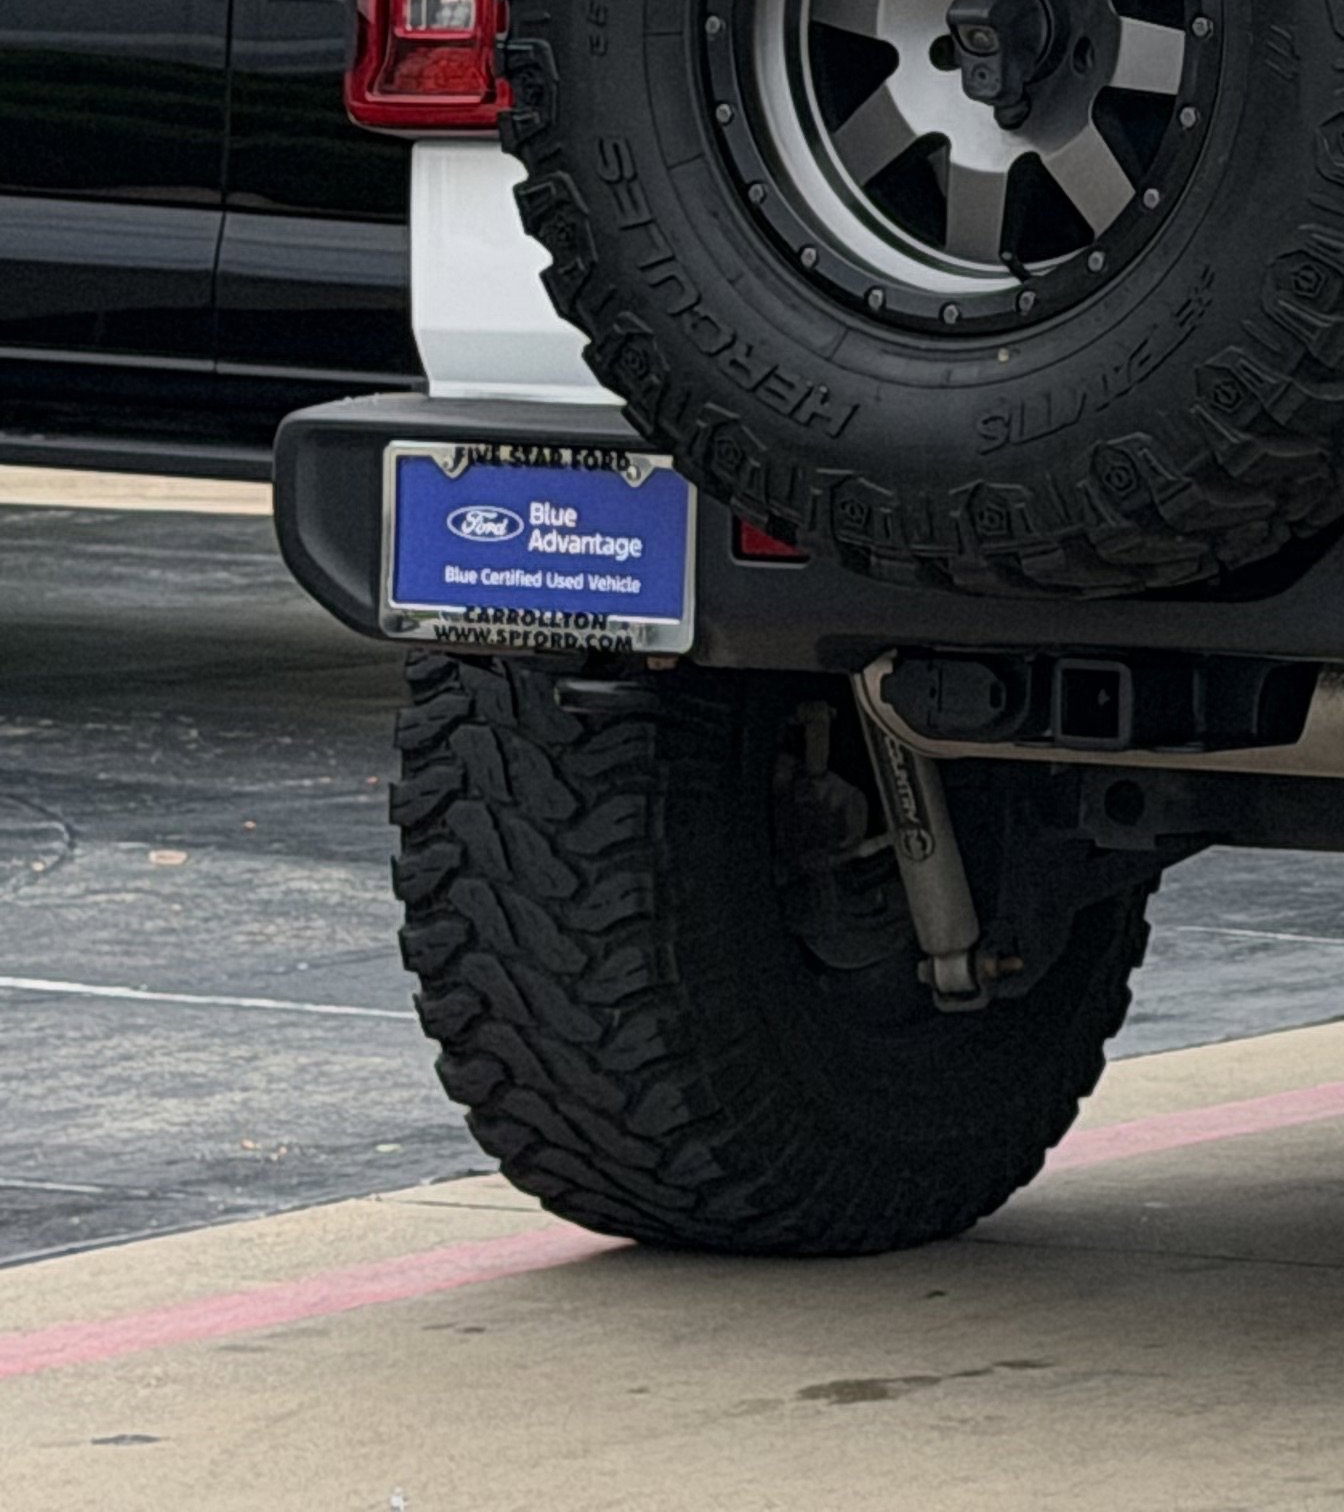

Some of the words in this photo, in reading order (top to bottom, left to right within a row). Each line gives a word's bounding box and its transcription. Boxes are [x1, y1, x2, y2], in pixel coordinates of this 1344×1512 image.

[597, 136, 860, 440] HERCULES
[573, 449, 630, 472] FORD
[460, 510, 509, 537] Ford
[529, 501, 577, 527] Blue
[527, 529, 643, 562] Advantage
[444, 565, 477, 584] Blue
[480, 568, 542, 588] Certified
[546, 571, 584, 590] Used
[587, 574, 641, 594] Vehicle
[464, 605, 608, 630] CARROLLTON
